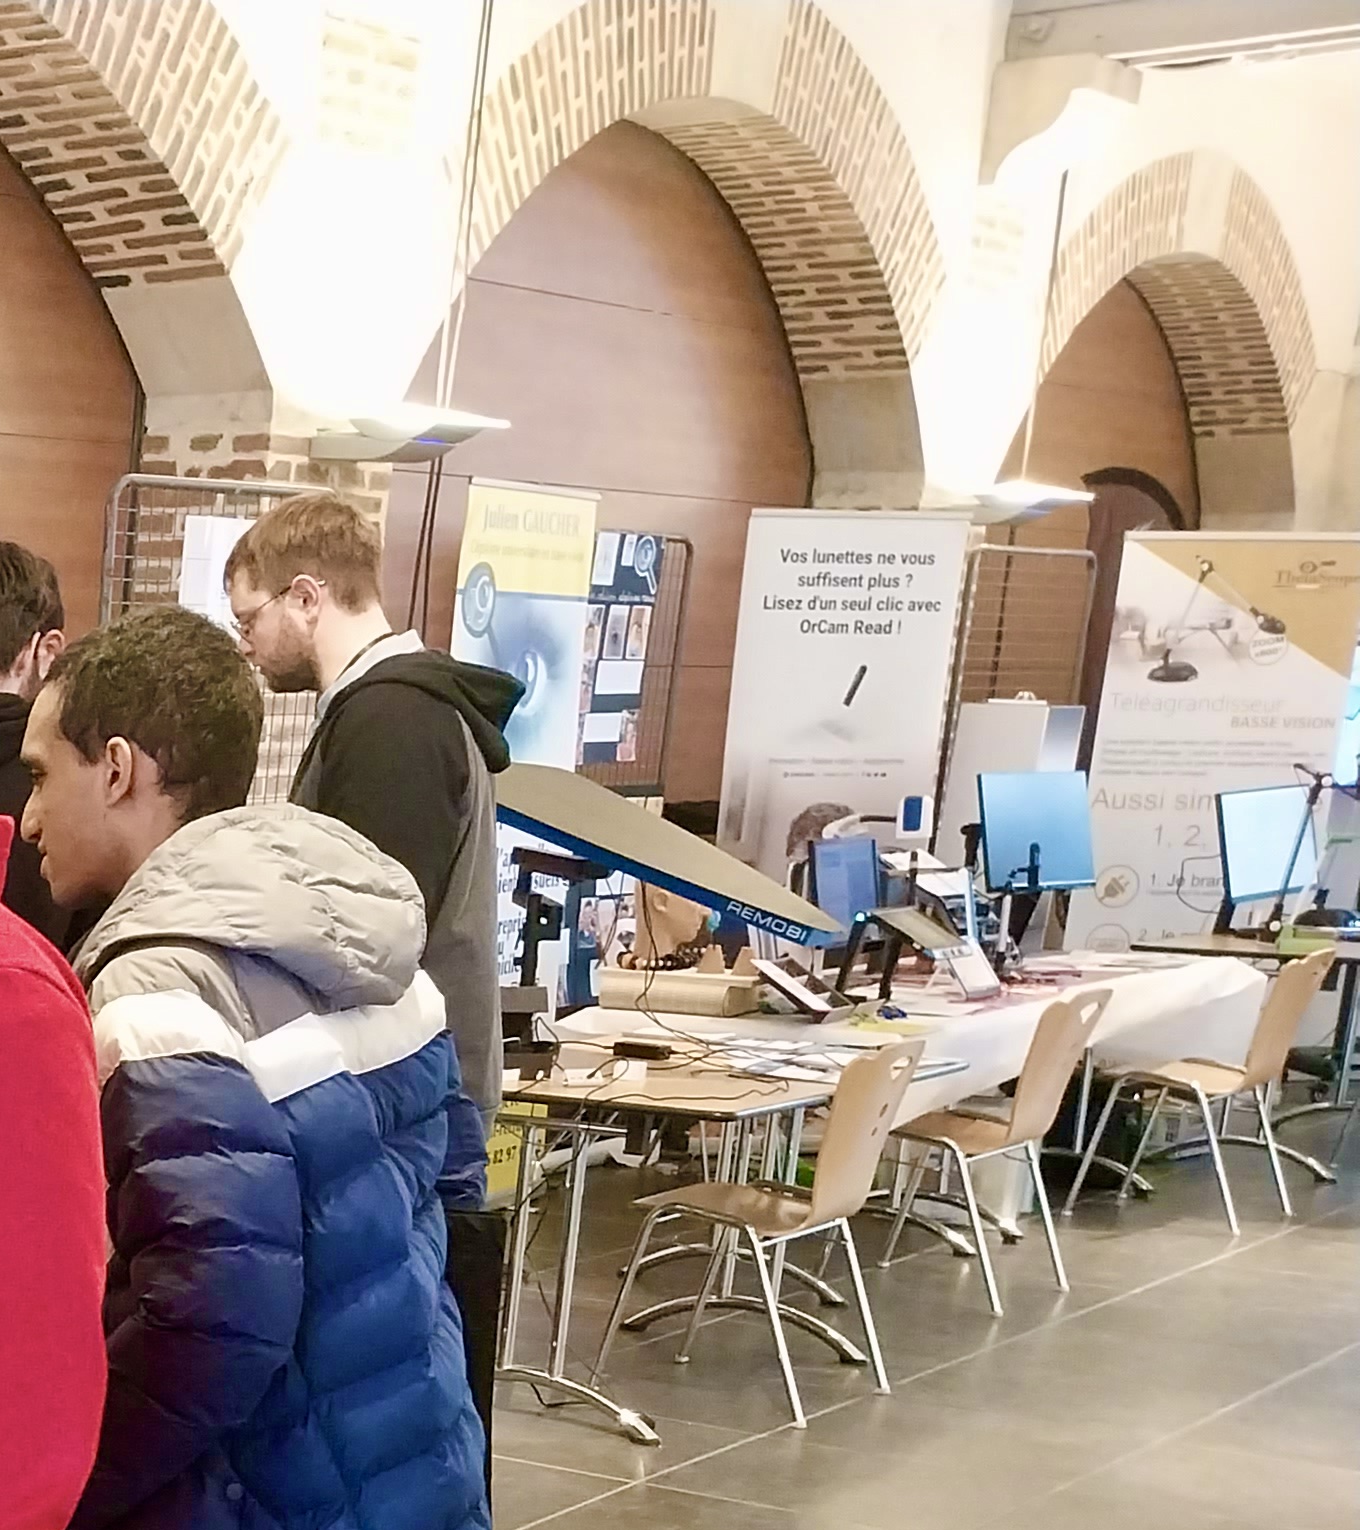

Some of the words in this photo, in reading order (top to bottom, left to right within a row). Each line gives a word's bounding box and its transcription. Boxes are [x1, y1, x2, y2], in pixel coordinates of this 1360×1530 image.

[780, 548, 808, 564] Vos
[812, 548, 873, 565] lunettes
[877, 552, 896, 565] ne
[900, 553, 936, 566] vous
[798, 571, 863, 588] suffisent
[867, 573, 900, 591] plus
[905, 573, 913, 588] ?
[763, 595, 803, 610] Lisez
[807, 595, 837, 611] d'un
[840, 596, 872, 611] seul
[876, 596, 903, 612] clic
[907, 600, 942, 612] avec
[800, 618, 849, 634] OrCam
[853, 619, 893, 635] Read
[896, 620, 902, 635] !
[1230, 716, 1279, 729] BASSE
[1282, 717, 1337, 730] VISION
[1091, 788, 1165, 812] Aussi
[726, 900, 807, 941] REMOBI
